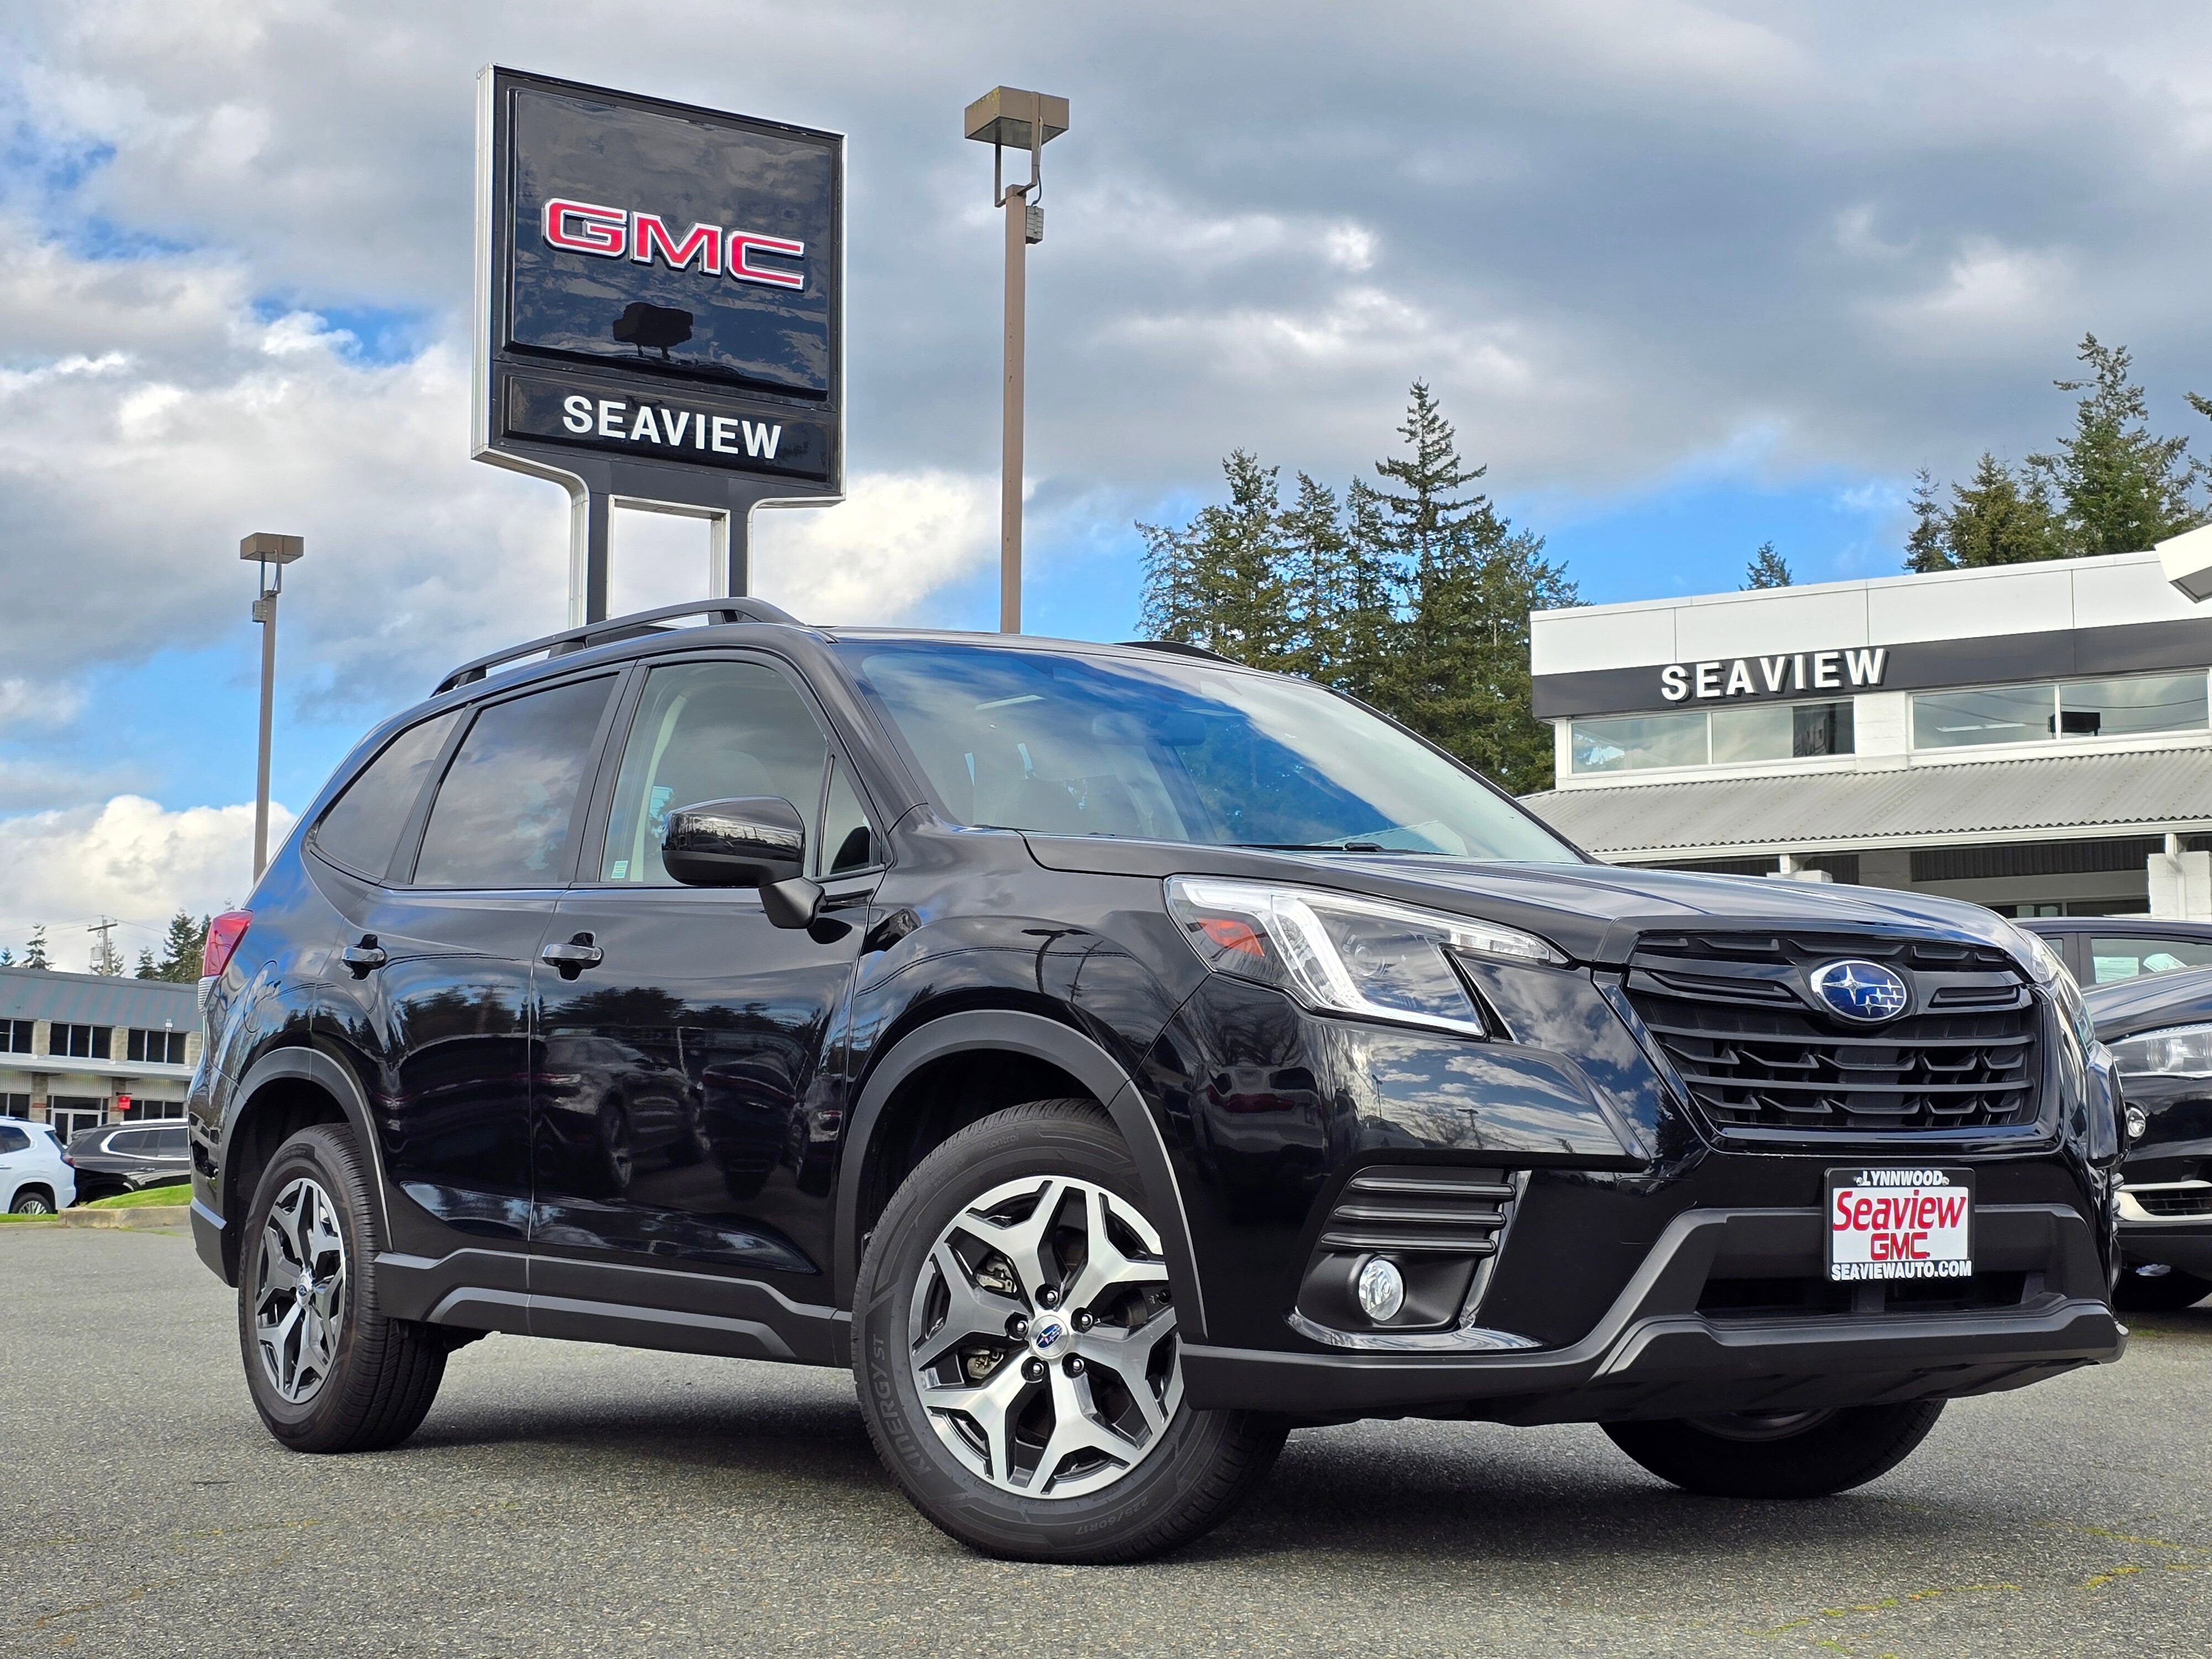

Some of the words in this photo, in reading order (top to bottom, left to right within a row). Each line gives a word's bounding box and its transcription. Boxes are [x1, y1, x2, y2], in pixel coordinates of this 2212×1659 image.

[542, 197, 805, 290] GMC
[562, 395, 782, 460] SEAVIEW
[1661, 648, 1888, 702] SEAVIEW
[1861, 1170, 1944, 1186] LYNNWOOD
[1833, 1190, 1966, 1231] Seaview
[1871, 1232, 1928, 1261] GMC
[1831, 1260, 1973, 1281] SEAVIEWAUTO.COM
[873, 1333, 885, 1360] ST
[871, 1361, 932, 1477] KINERGY
[1074, 1496, 1149, 1535] 225/60R17
